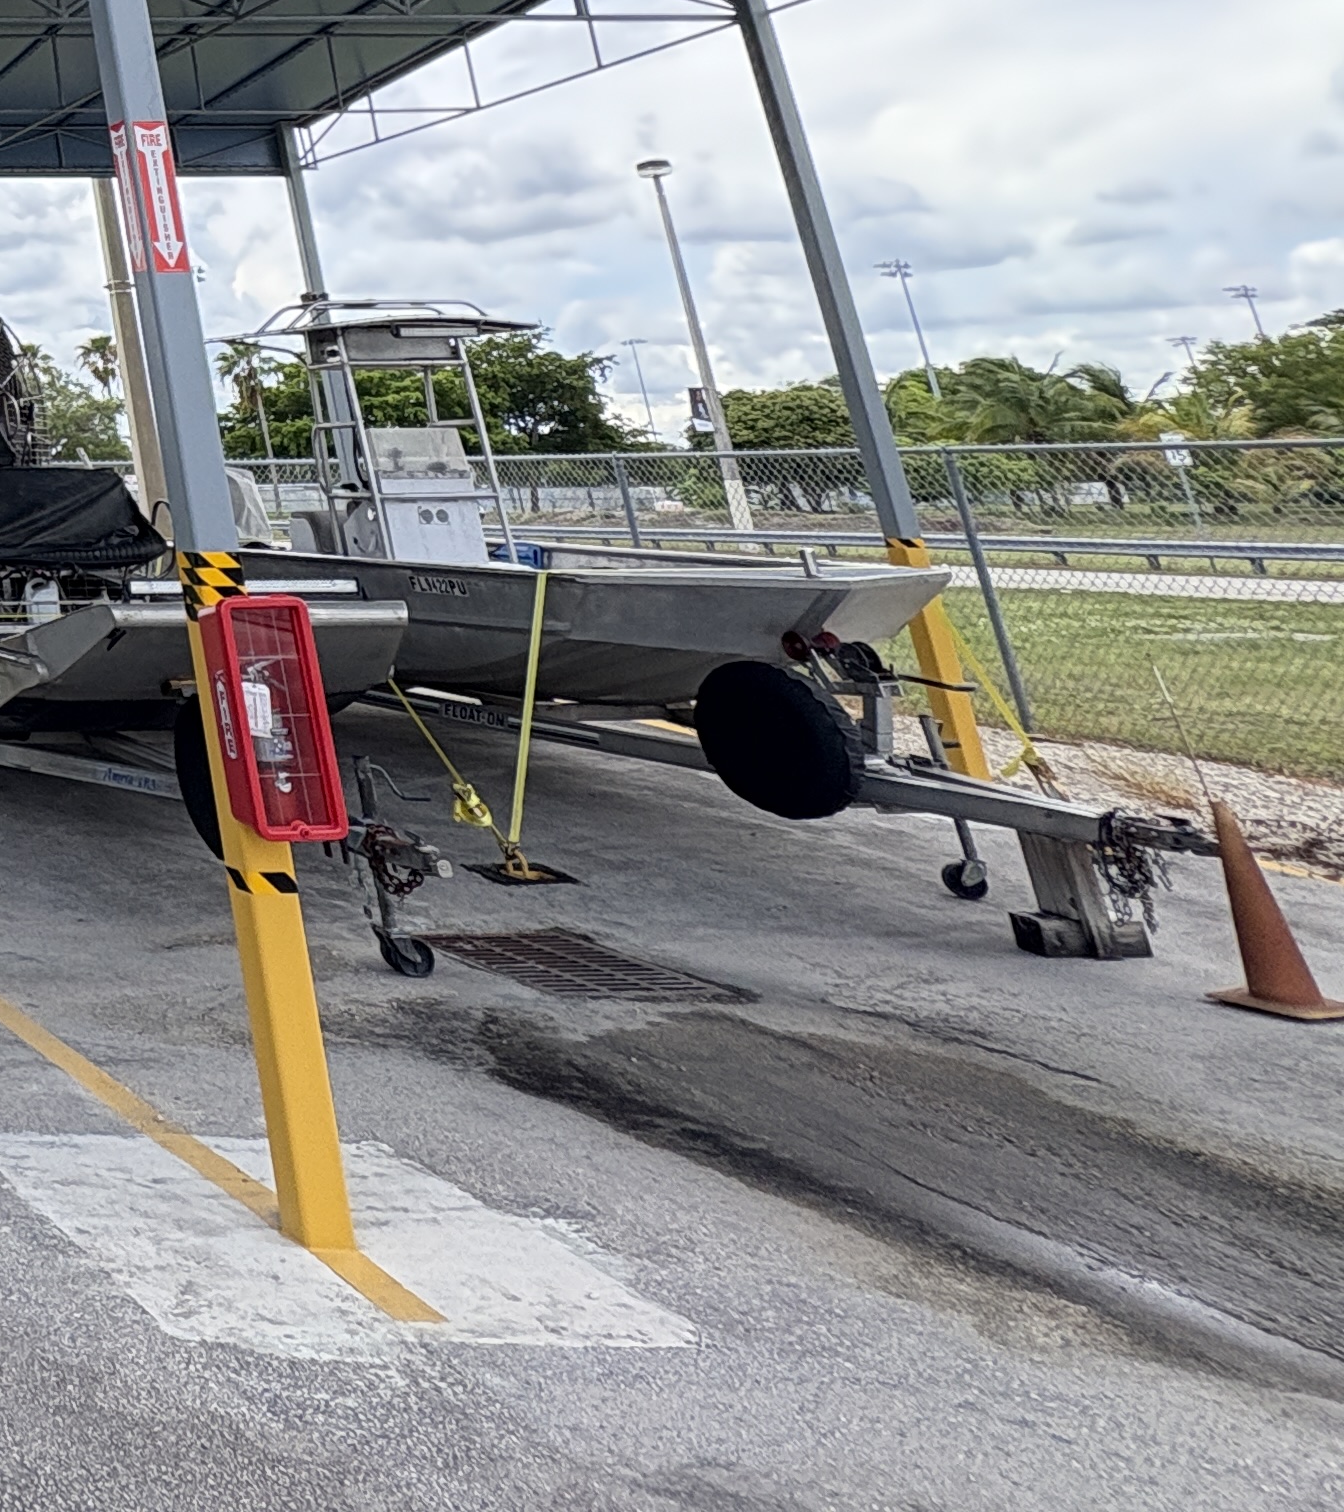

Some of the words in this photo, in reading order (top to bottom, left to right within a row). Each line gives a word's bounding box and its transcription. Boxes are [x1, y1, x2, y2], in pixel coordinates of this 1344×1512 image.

[140, 133, 163, 147] FIRE
[150, 149, 175, 260] EXTINGUISHER
[219, 690, 236, 755] FIRE
[444, 703, 504, 726] FLOAT-ON
